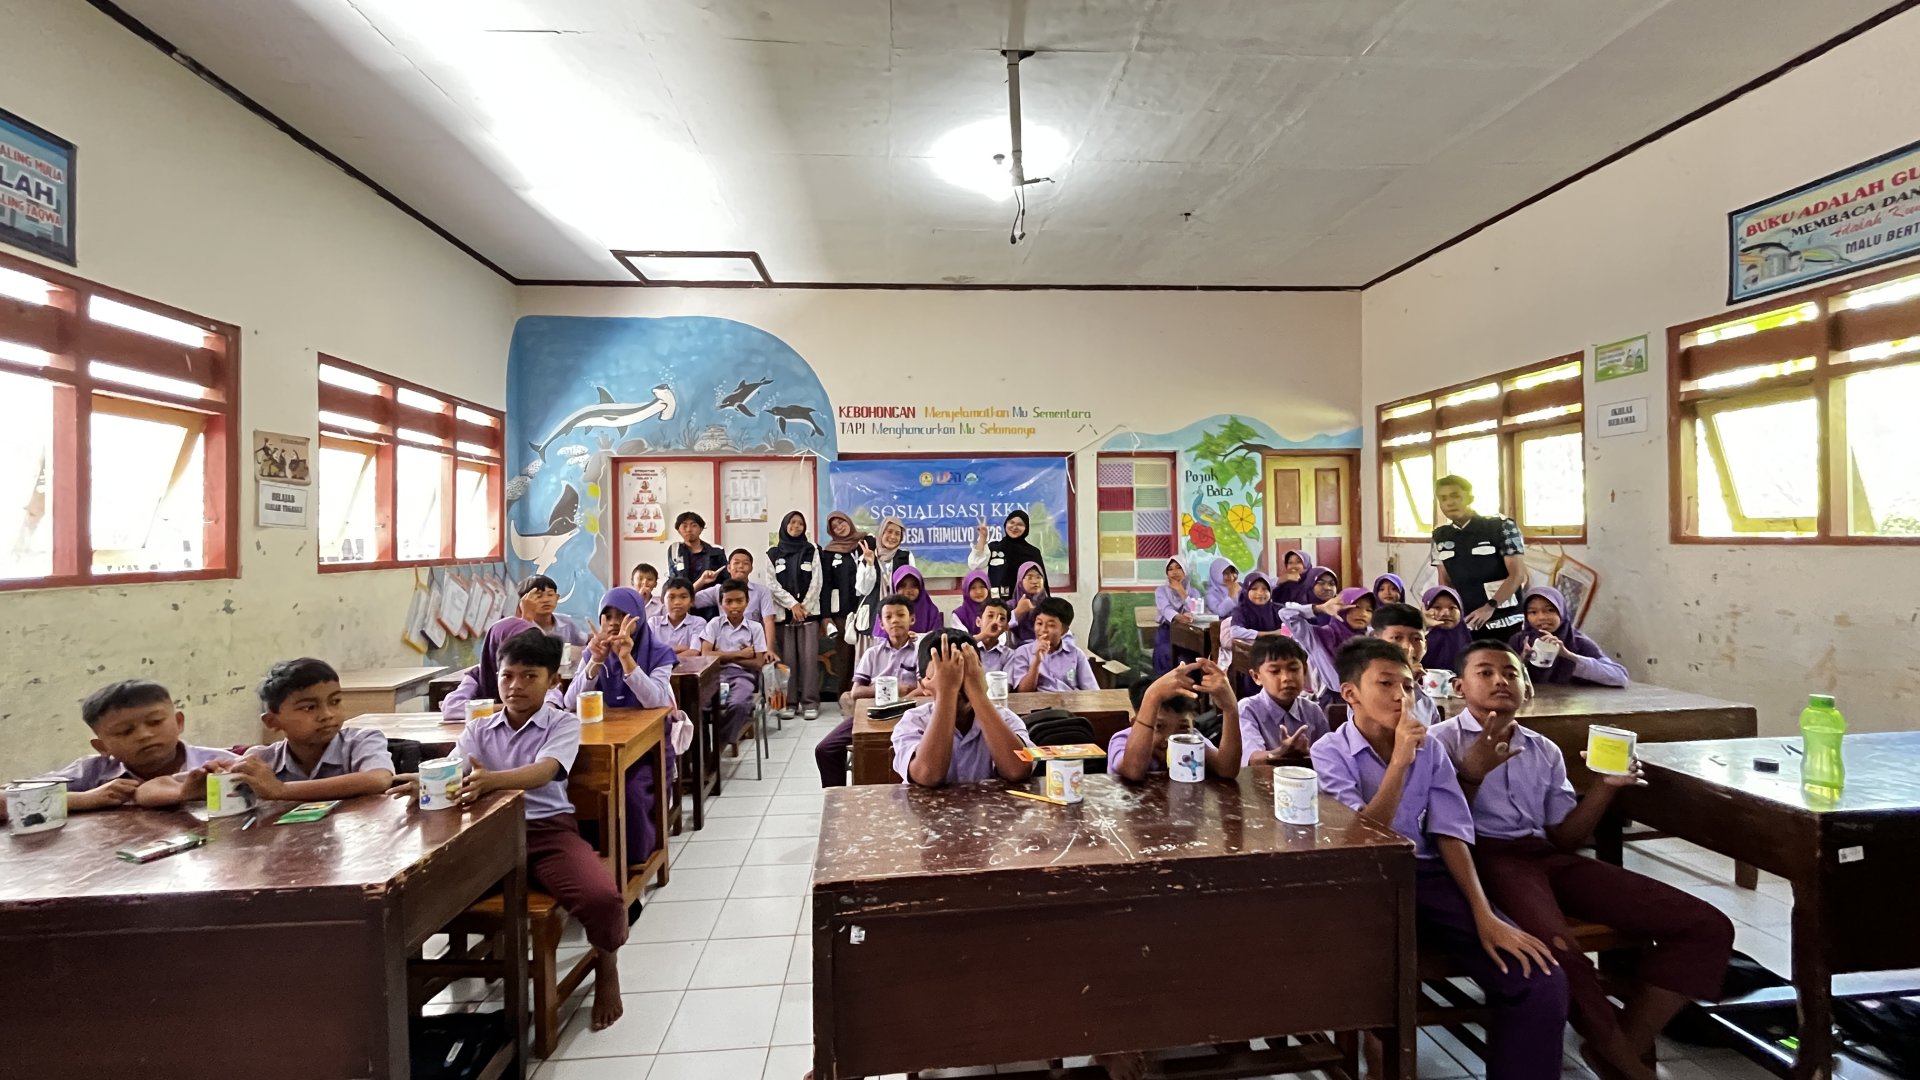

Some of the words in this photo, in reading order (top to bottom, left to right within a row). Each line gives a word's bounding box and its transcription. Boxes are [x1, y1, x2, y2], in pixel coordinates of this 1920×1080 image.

[0, 193, 24, 209] LING
[26, 203, 62, 225] TAQWA
[1746, 212, 1794, 238] BUKU
[1798, 179, 1885, 217] ADALAH
[1791, 202, 1876, 238] MEMBACA
[1846, 234, 1882, 254] MALU
[838, 406, 916, 419] KEBOHONGAN
[1032, 406, 1092, 419] Sementara
[840, 421, 866, 435] TAPI
[872, 422, 956, 439] Menghancurkan
[959, 422, 976, 435] Mu
[979, 422, 1036, 439] Selamanya
[1206, 484, 1234, 497] Baca
[870, 503, 985, 520] SOSIALISASI
[928, 526, 975, 544] TRIMULYO
